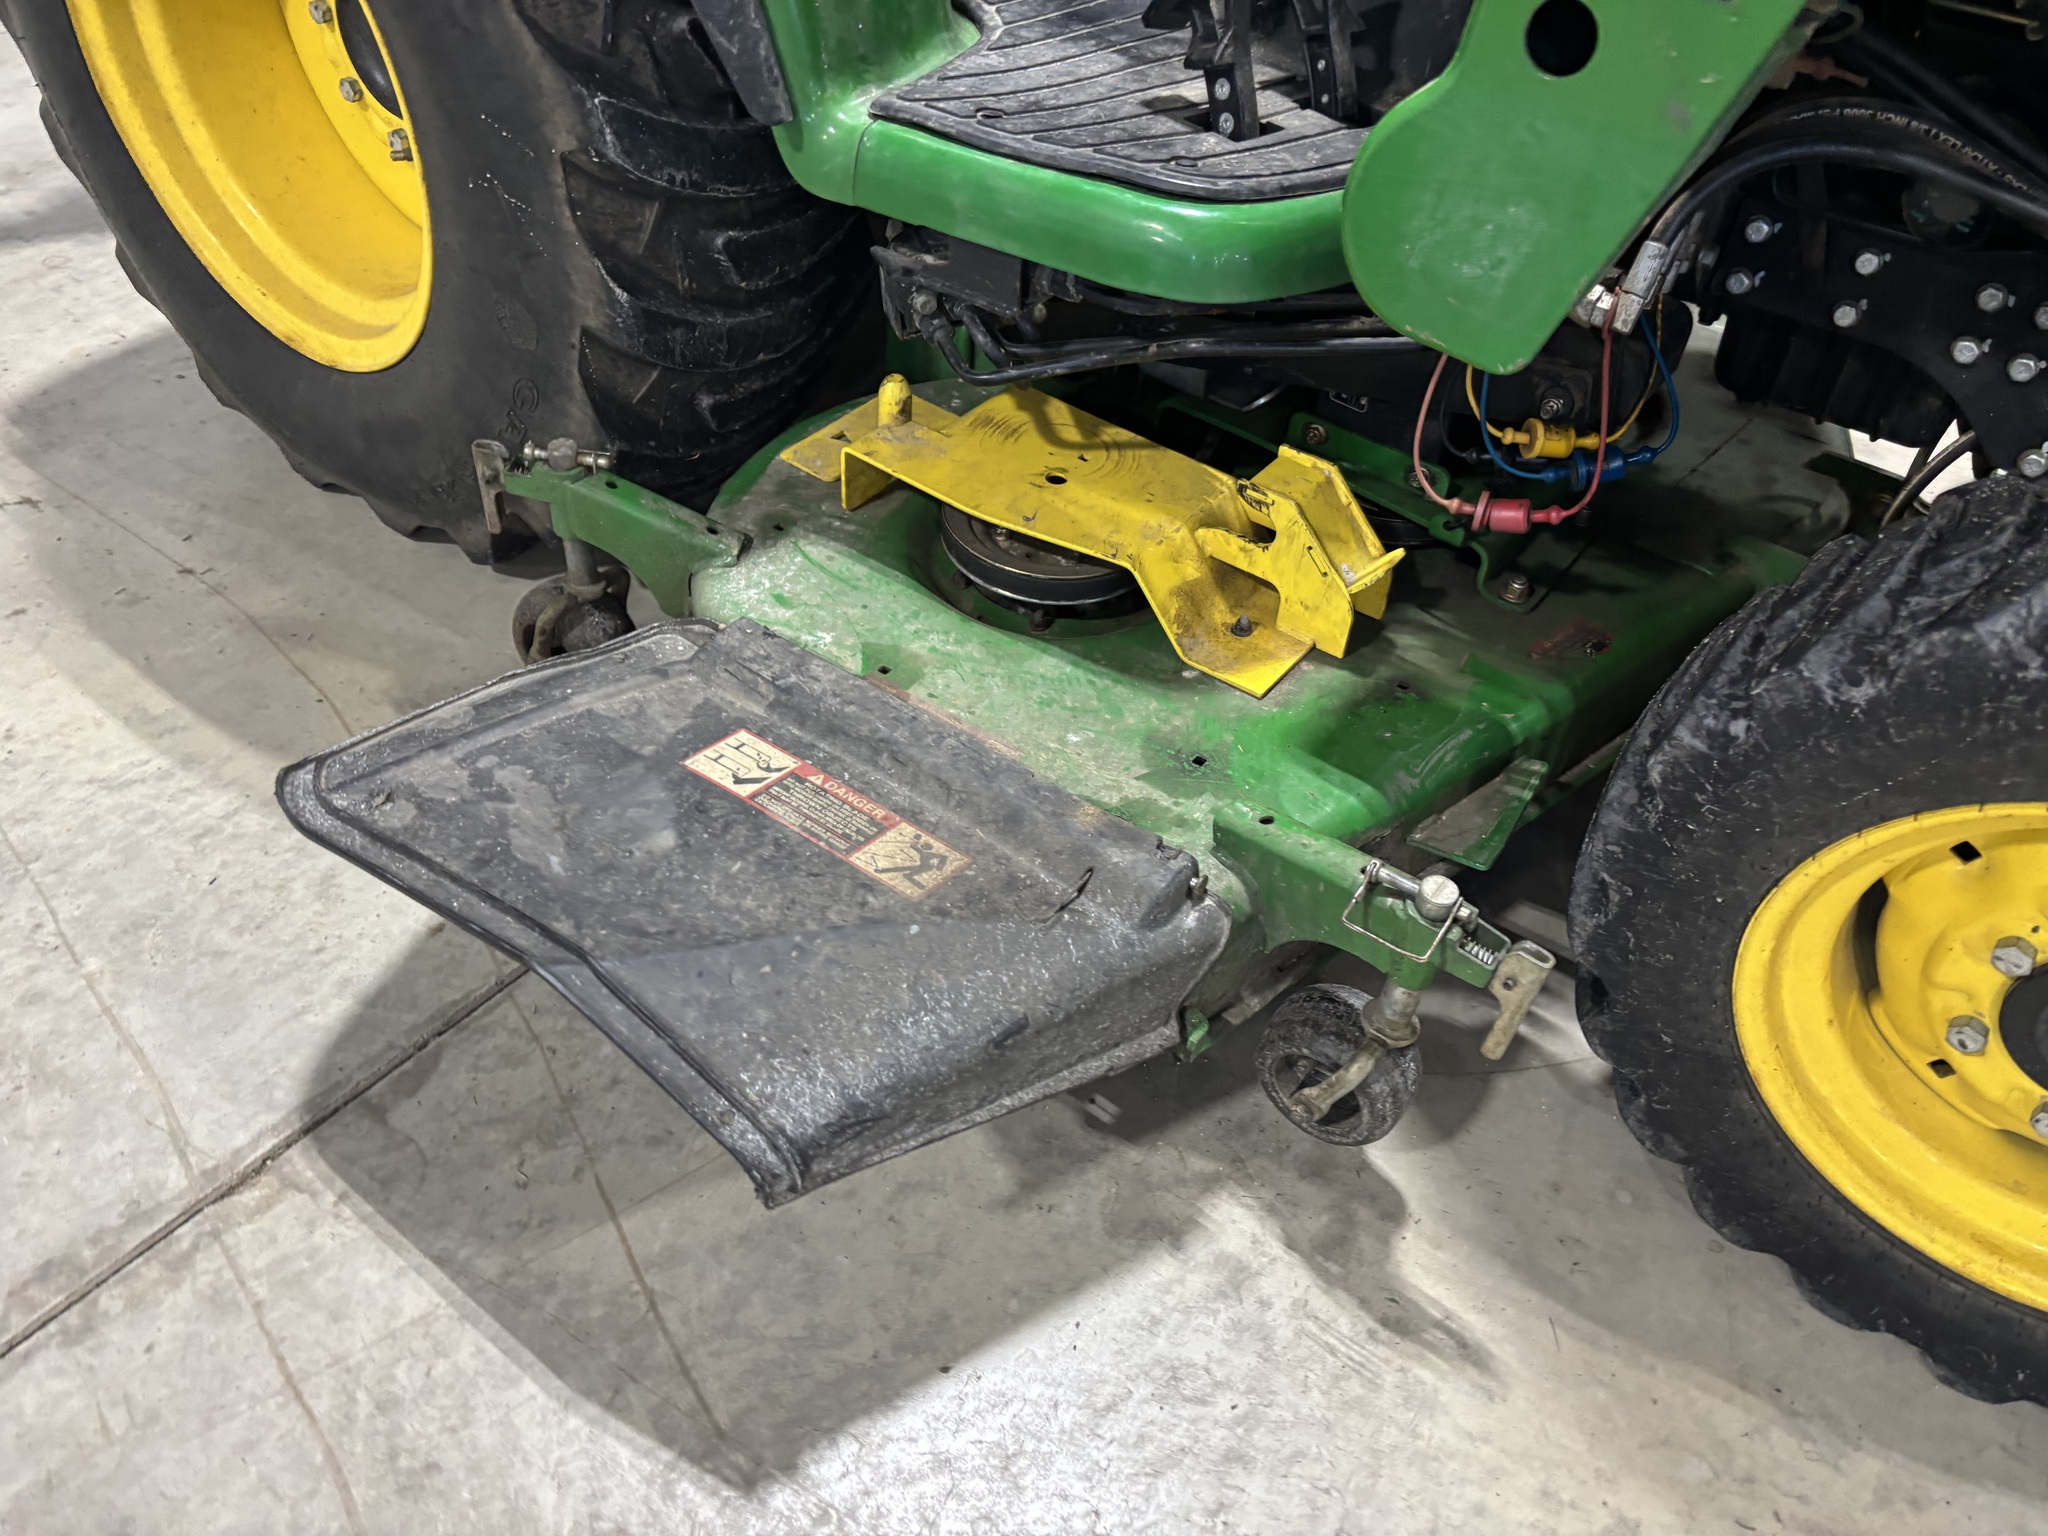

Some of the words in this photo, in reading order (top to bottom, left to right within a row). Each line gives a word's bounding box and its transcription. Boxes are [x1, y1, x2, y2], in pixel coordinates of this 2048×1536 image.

[787, 789, 823, 810] THROWN
[820, 809, 859, 831] OBJECTS
[803, 782, 843, 805] ROTATING
[841, 804, 870, 821] BLADE
[822, 780, 887, 818] DANGER
